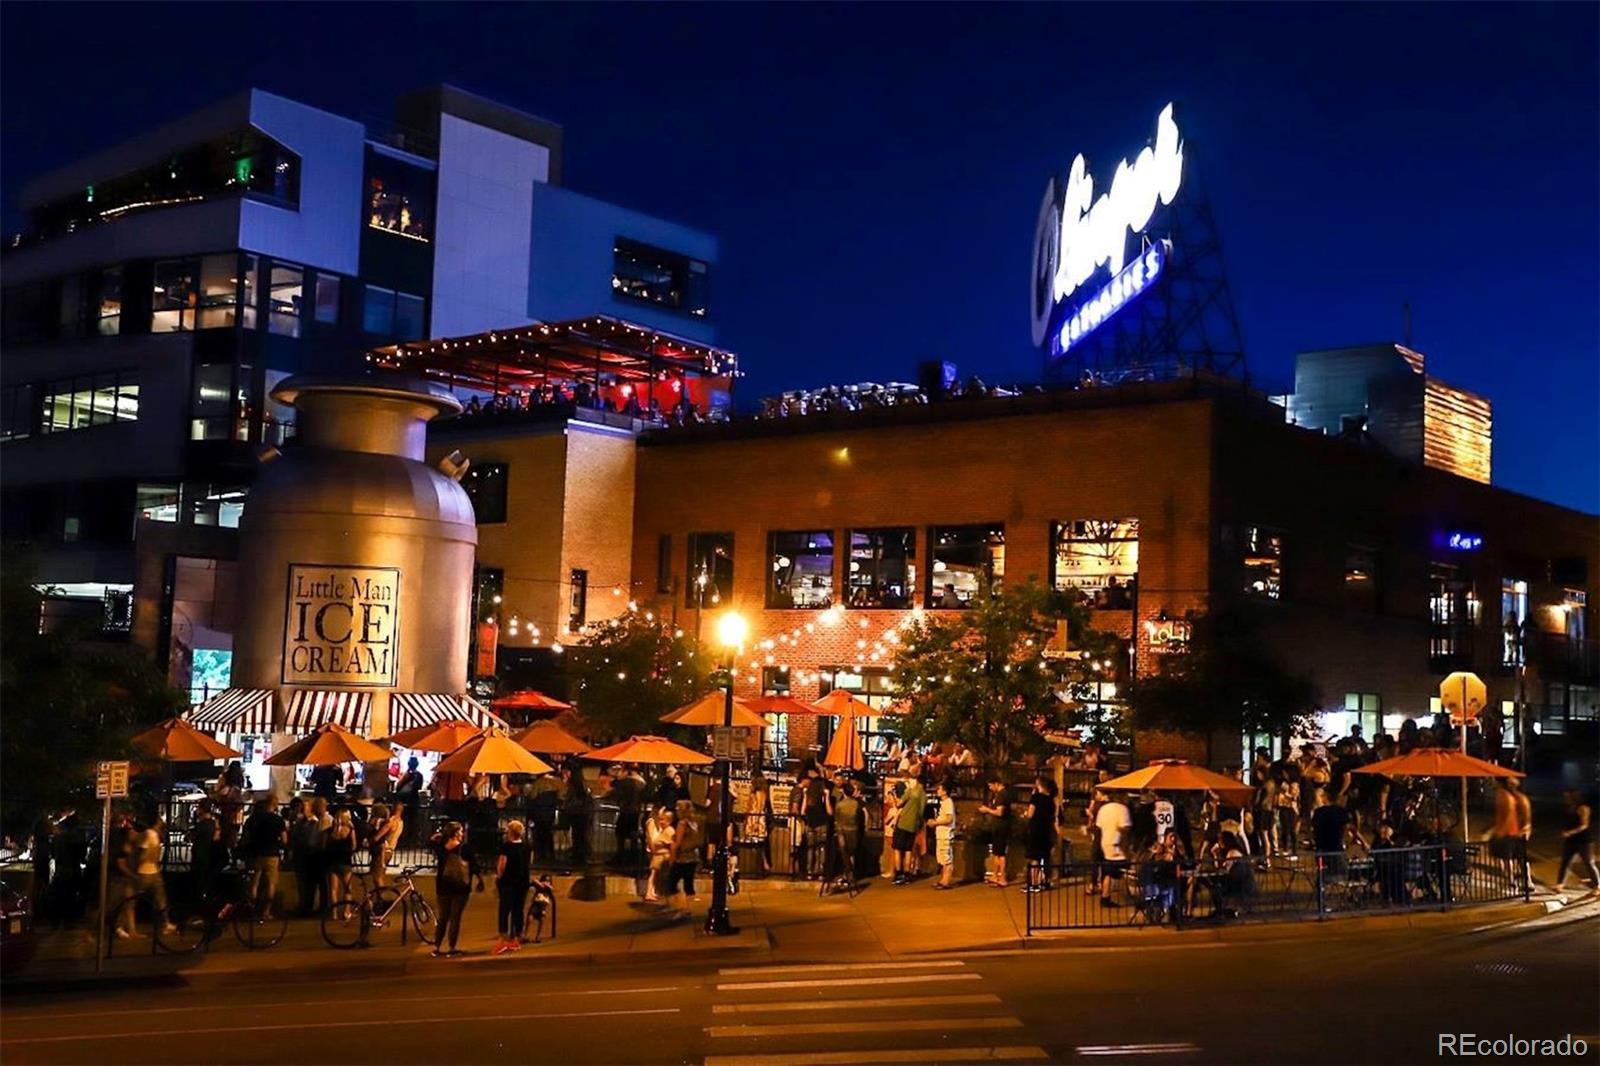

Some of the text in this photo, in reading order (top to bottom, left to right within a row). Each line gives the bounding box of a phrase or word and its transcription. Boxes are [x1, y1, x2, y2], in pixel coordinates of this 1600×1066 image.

[296, 574, 391, 600] Little Man
[294, 602, 390, 645] ICE
[291, 645, 389, 675] CREAM
[1158, 813, 1172, 825] 30
